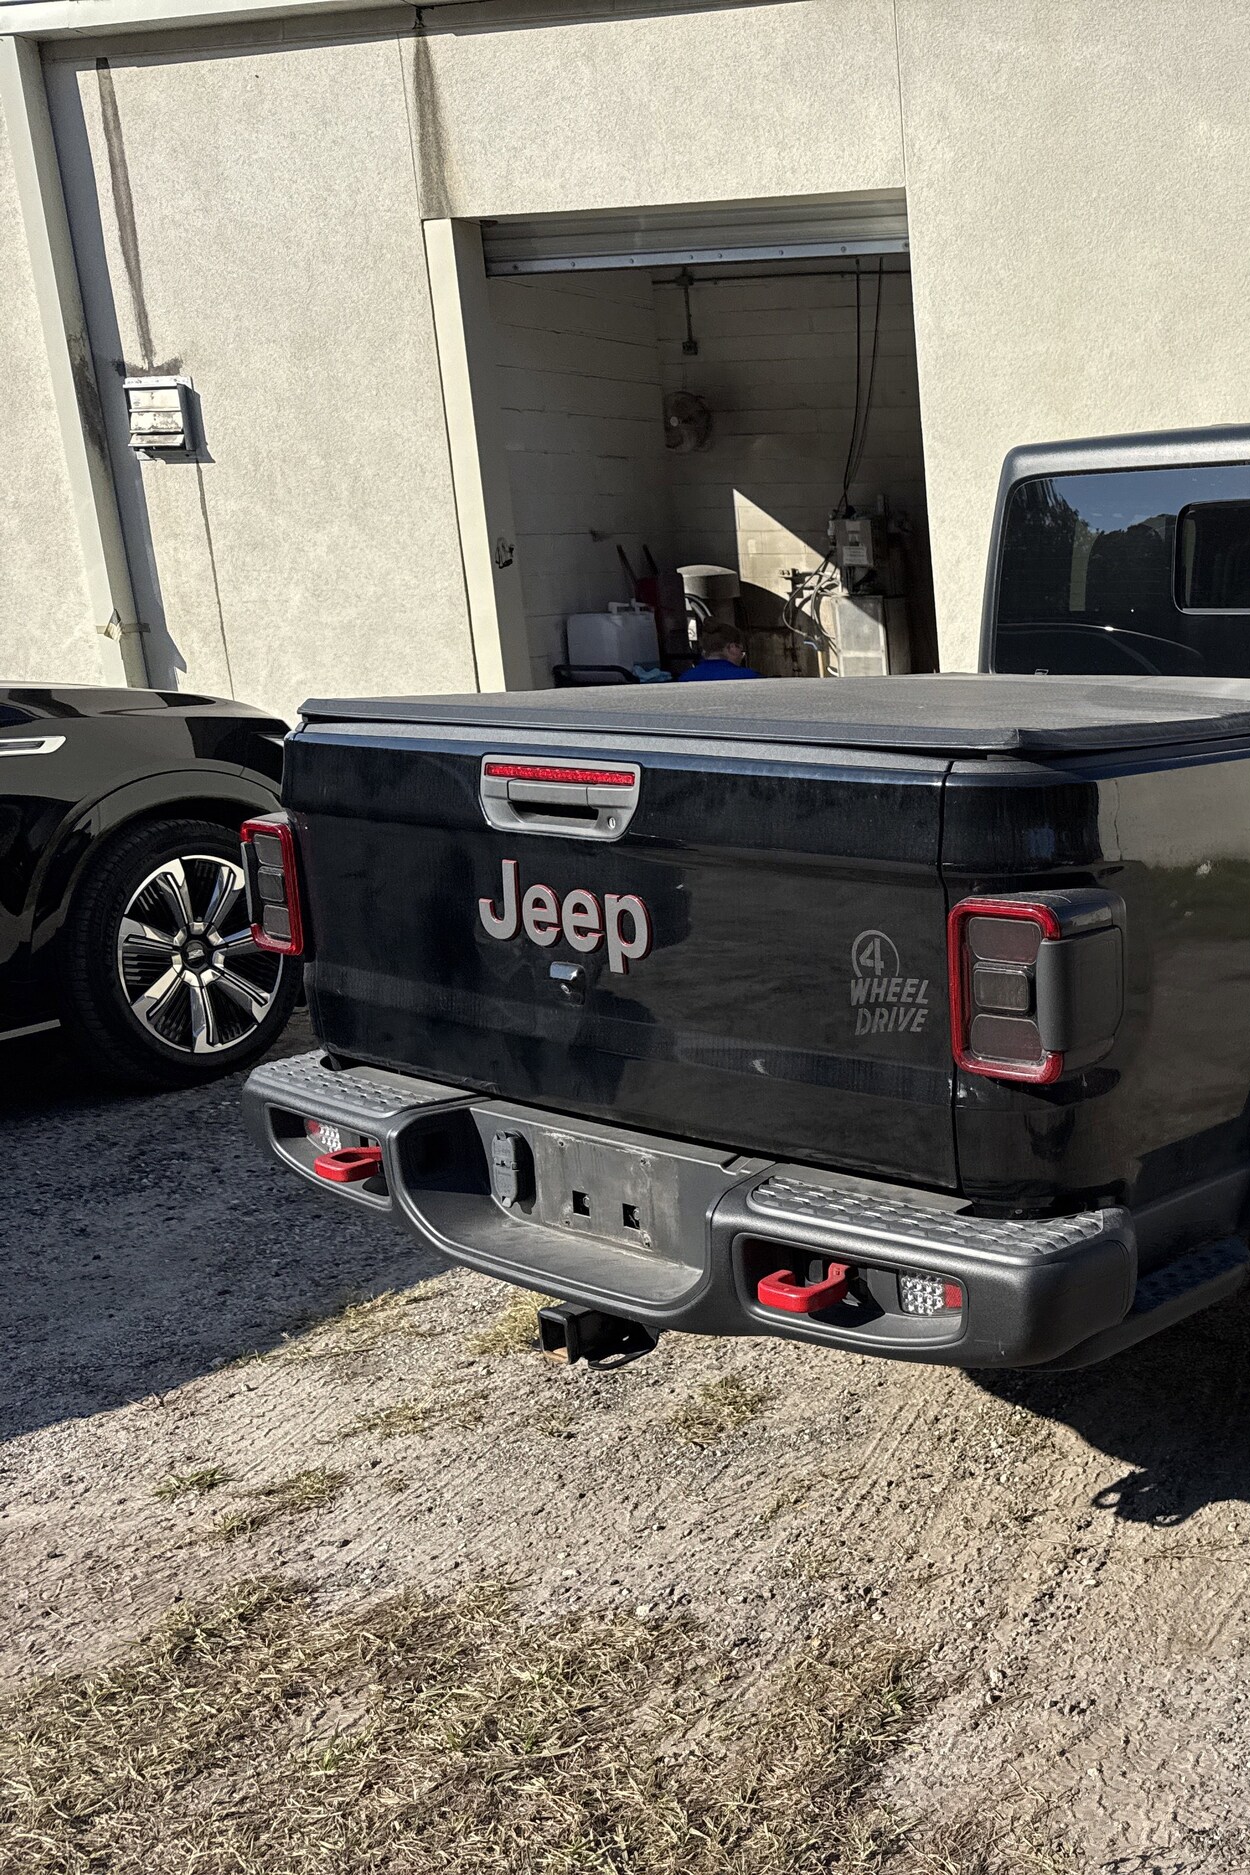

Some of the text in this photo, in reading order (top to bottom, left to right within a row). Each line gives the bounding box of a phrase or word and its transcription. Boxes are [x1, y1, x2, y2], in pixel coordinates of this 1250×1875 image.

[478, 859, 653, 975] Jeep
[859, 938, 885, 976] 4
[850, 977, 929, 1006] WHEEL
[854, 1006, 929, 1036] DRIVE
